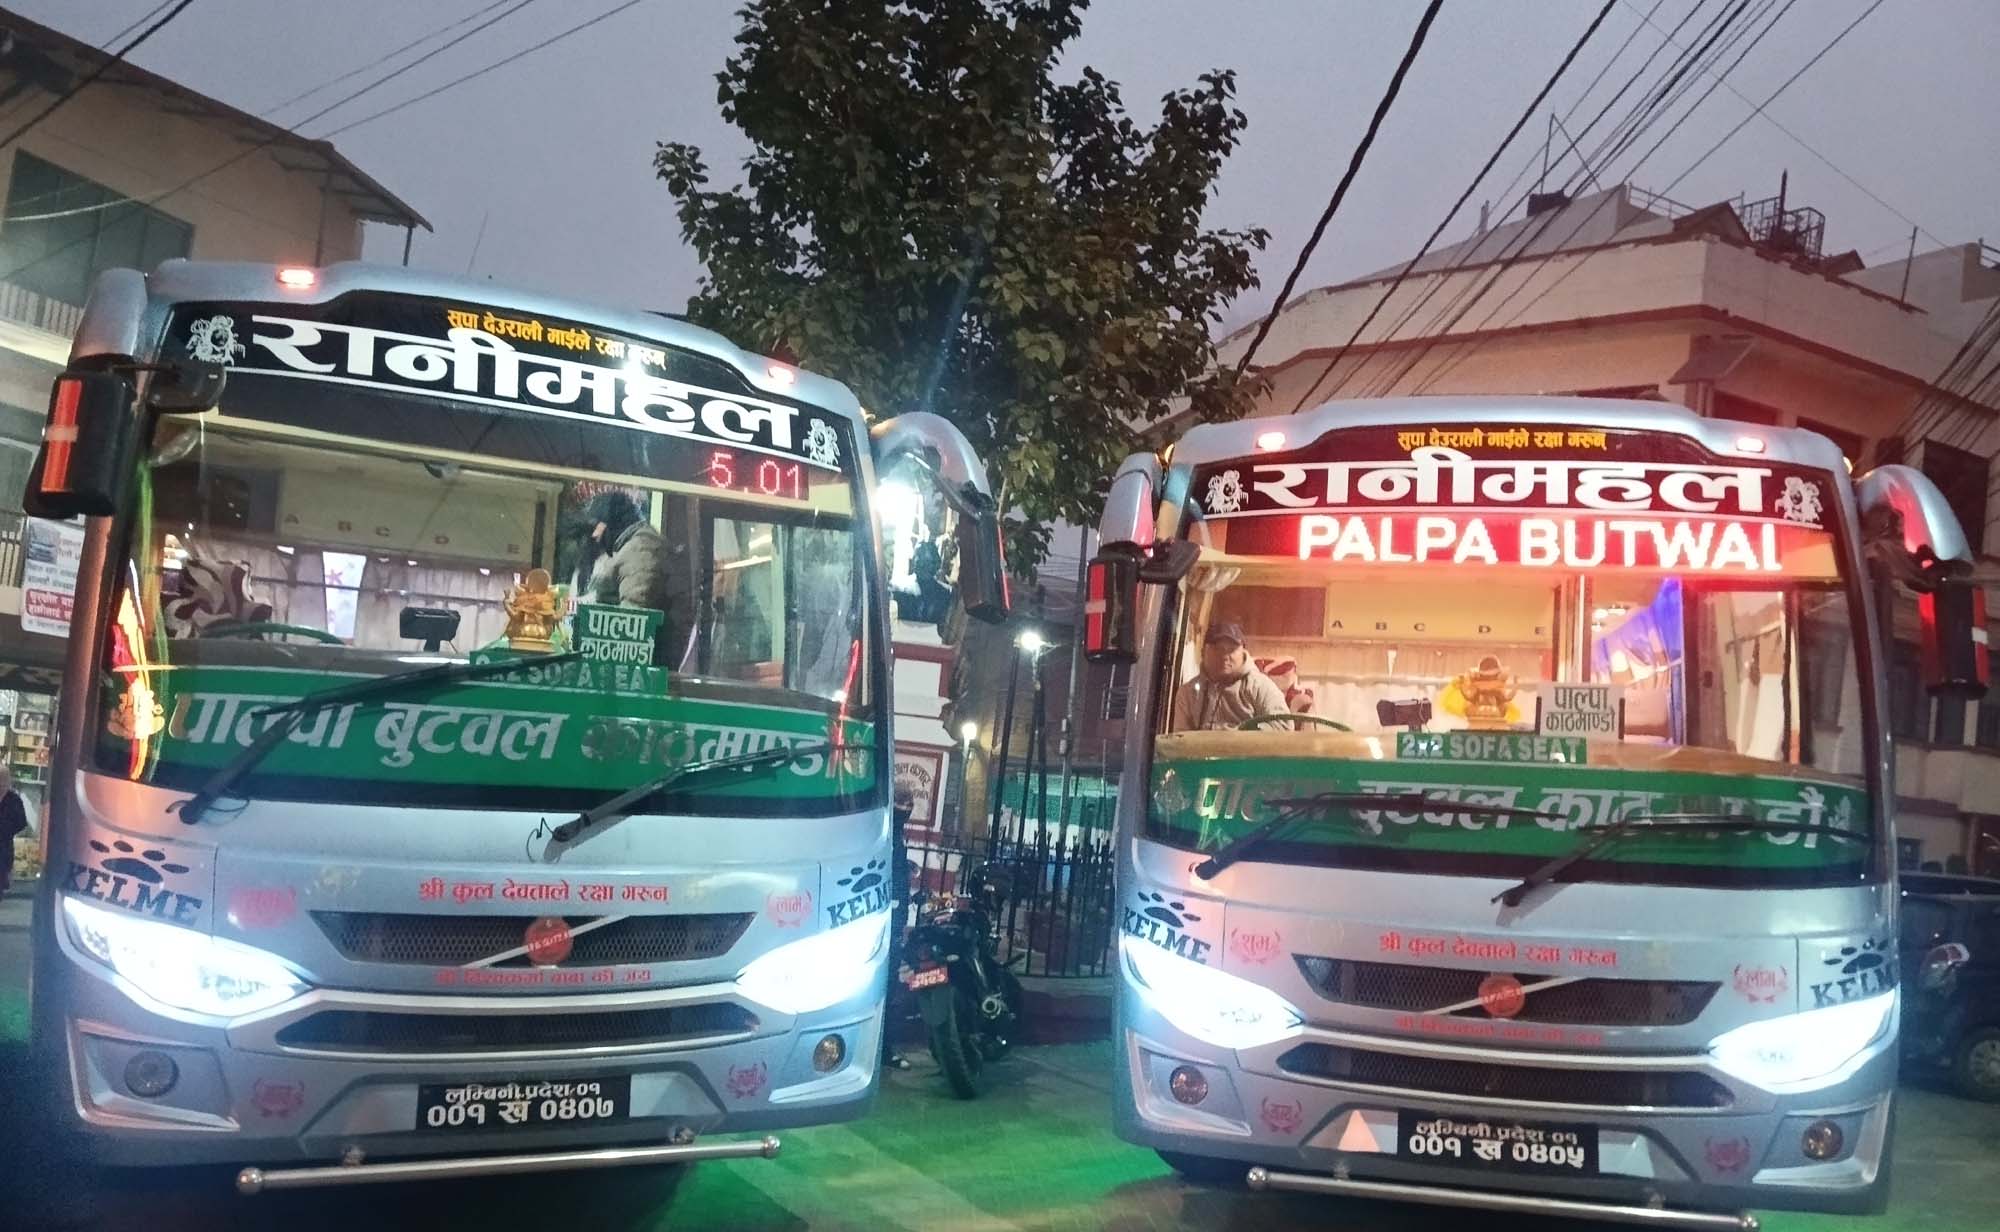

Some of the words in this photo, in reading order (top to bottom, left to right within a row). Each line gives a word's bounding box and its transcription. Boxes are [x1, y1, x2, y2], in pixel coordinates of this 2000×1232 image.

[252, 314, 799, 449] रानीमहल
[1253, 447, 1772, 510] रानीमहल
[1299, 514, 1501, 565] PALPA
[588, 609, 649, 641] पाल्पा
[1554, 686, 1609, 713] पाल्पा
[374, 702, 568, 767] बुटवल
[1450, 735, 1512, 761] SOFA
[1518, 736, 1581, 764] SEAT
[64, 861, 202, 926] KELME
[419, 877, 444, 901] श्री
[452, 883, 495, 904] कुल
[1122, 905, 1211, 965] KELME
[427, 1104, 485, 1127] ००१
[498, 1100, 530, 1124] ख
[540, 1097, 614, 1120] ०४०७
[1409, 1135, 1462, 1158] ००१
[1472, 1137, 1503, 1160] ख
